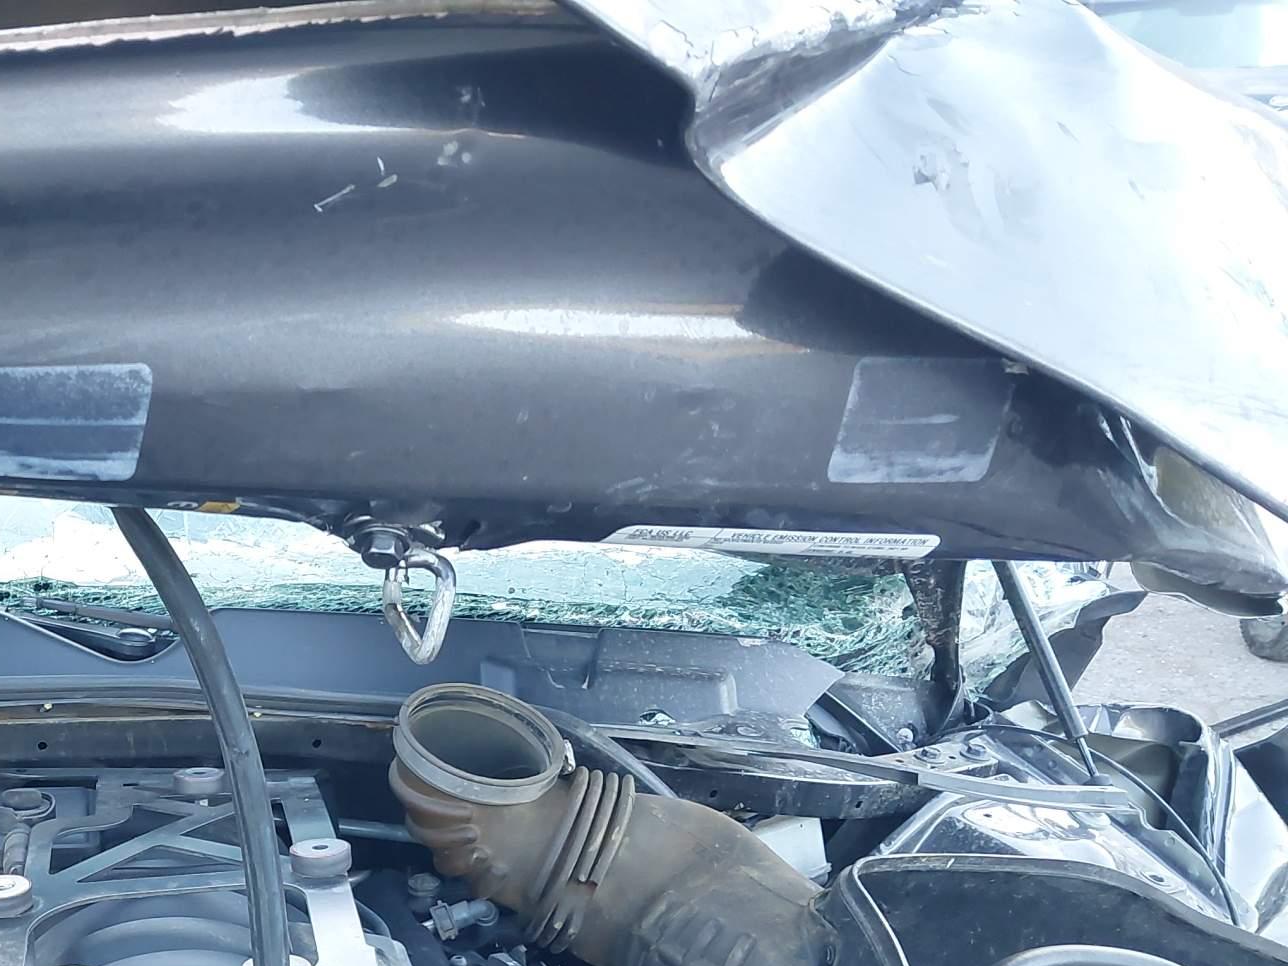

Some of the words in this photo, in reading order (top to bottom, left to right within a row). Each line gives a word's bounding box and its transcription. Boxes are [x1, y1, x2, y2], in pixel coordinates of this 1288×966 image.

[731, 532, 772, 542] VEHICLE
[772, 534, 818, 544] EMISSION
[818, 536, 861, 544] CONTROL
